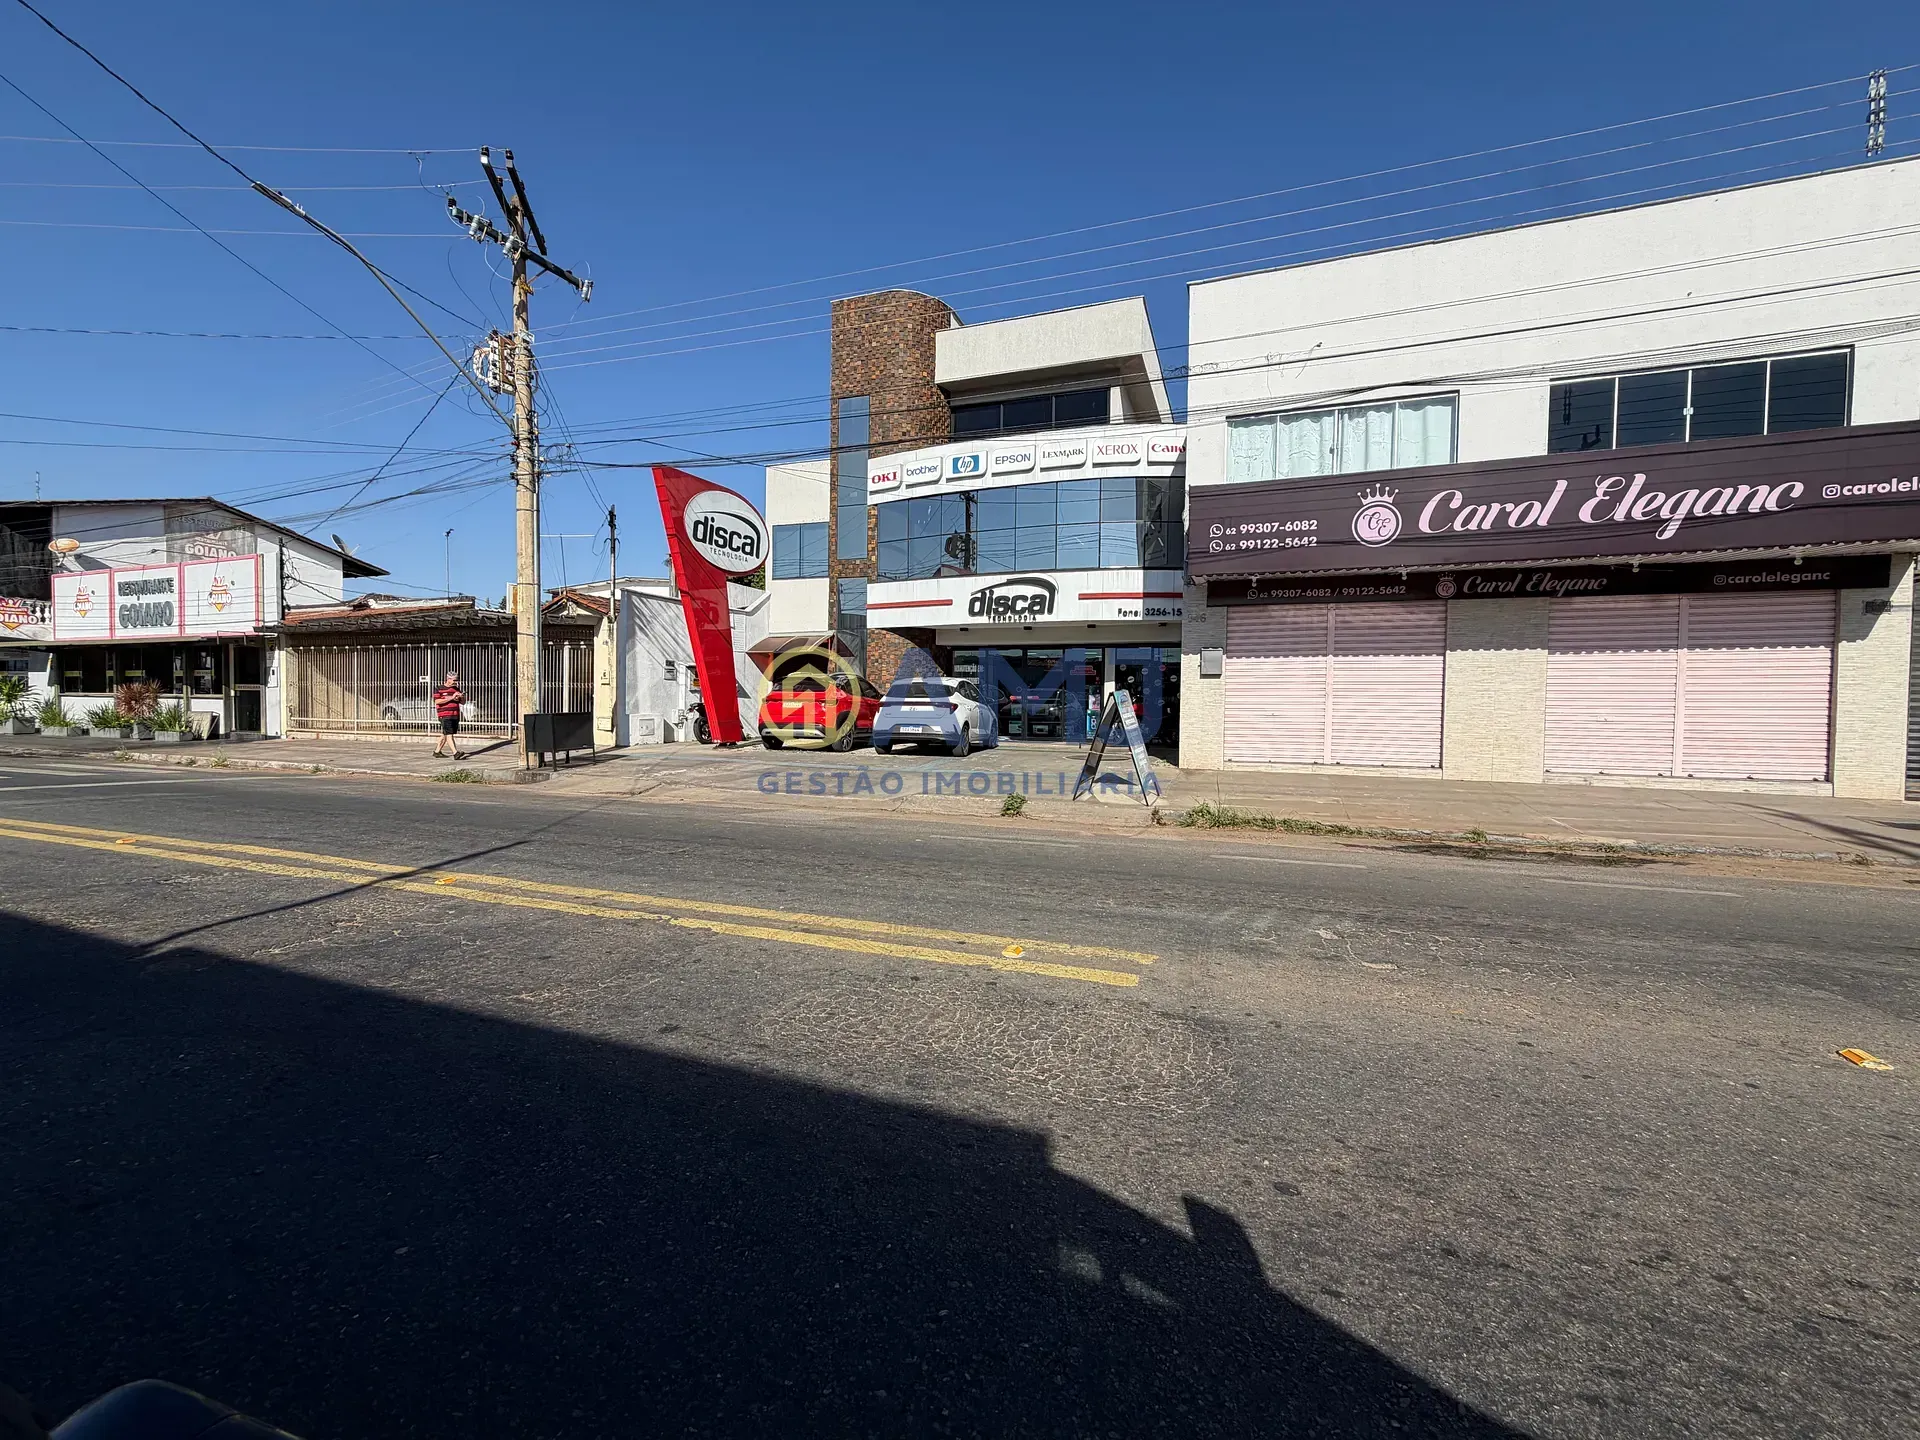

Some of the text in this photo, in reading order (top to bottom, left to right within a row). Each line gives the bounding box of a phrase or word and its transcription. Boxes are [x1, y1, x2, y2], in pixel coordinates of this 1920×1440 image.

[1042, 447, 1085, 459] LEXMARK
[1097, 443, 1139, 456] XEROX
[960, 456, 972, 473] hp
[995, 453, 1031, 465] EPSON
[871, 471, 897, 484] OKI
[906, 464, 939, 477] brother
[1842, 476, 1920, 496] carolel
[1418, 473, 1804, 540] Carol Eleganc
[692, 510, 761, 559] discal
[1225, 519, 1318, 536] 62 99307-6082
[185, 543, 237, 558] GOIANO
[1225, 536, 1318, 551] 62 99122-5642
[710, 547, 749, 562] TECNOLOGIA
[1463, 572, 1607, 597] Carol Eleganc
[1728, 572, 1831, 584] caroleleganc
[968, 575, 1058, 617] discal
[1271, 587, 1331, 598] 99307-6082
[1342, 586, 1406, 597] 99122-5642
[119, 601, 174, 628] GOIANO
[1144, 607, 1183, 618] 3256-15
